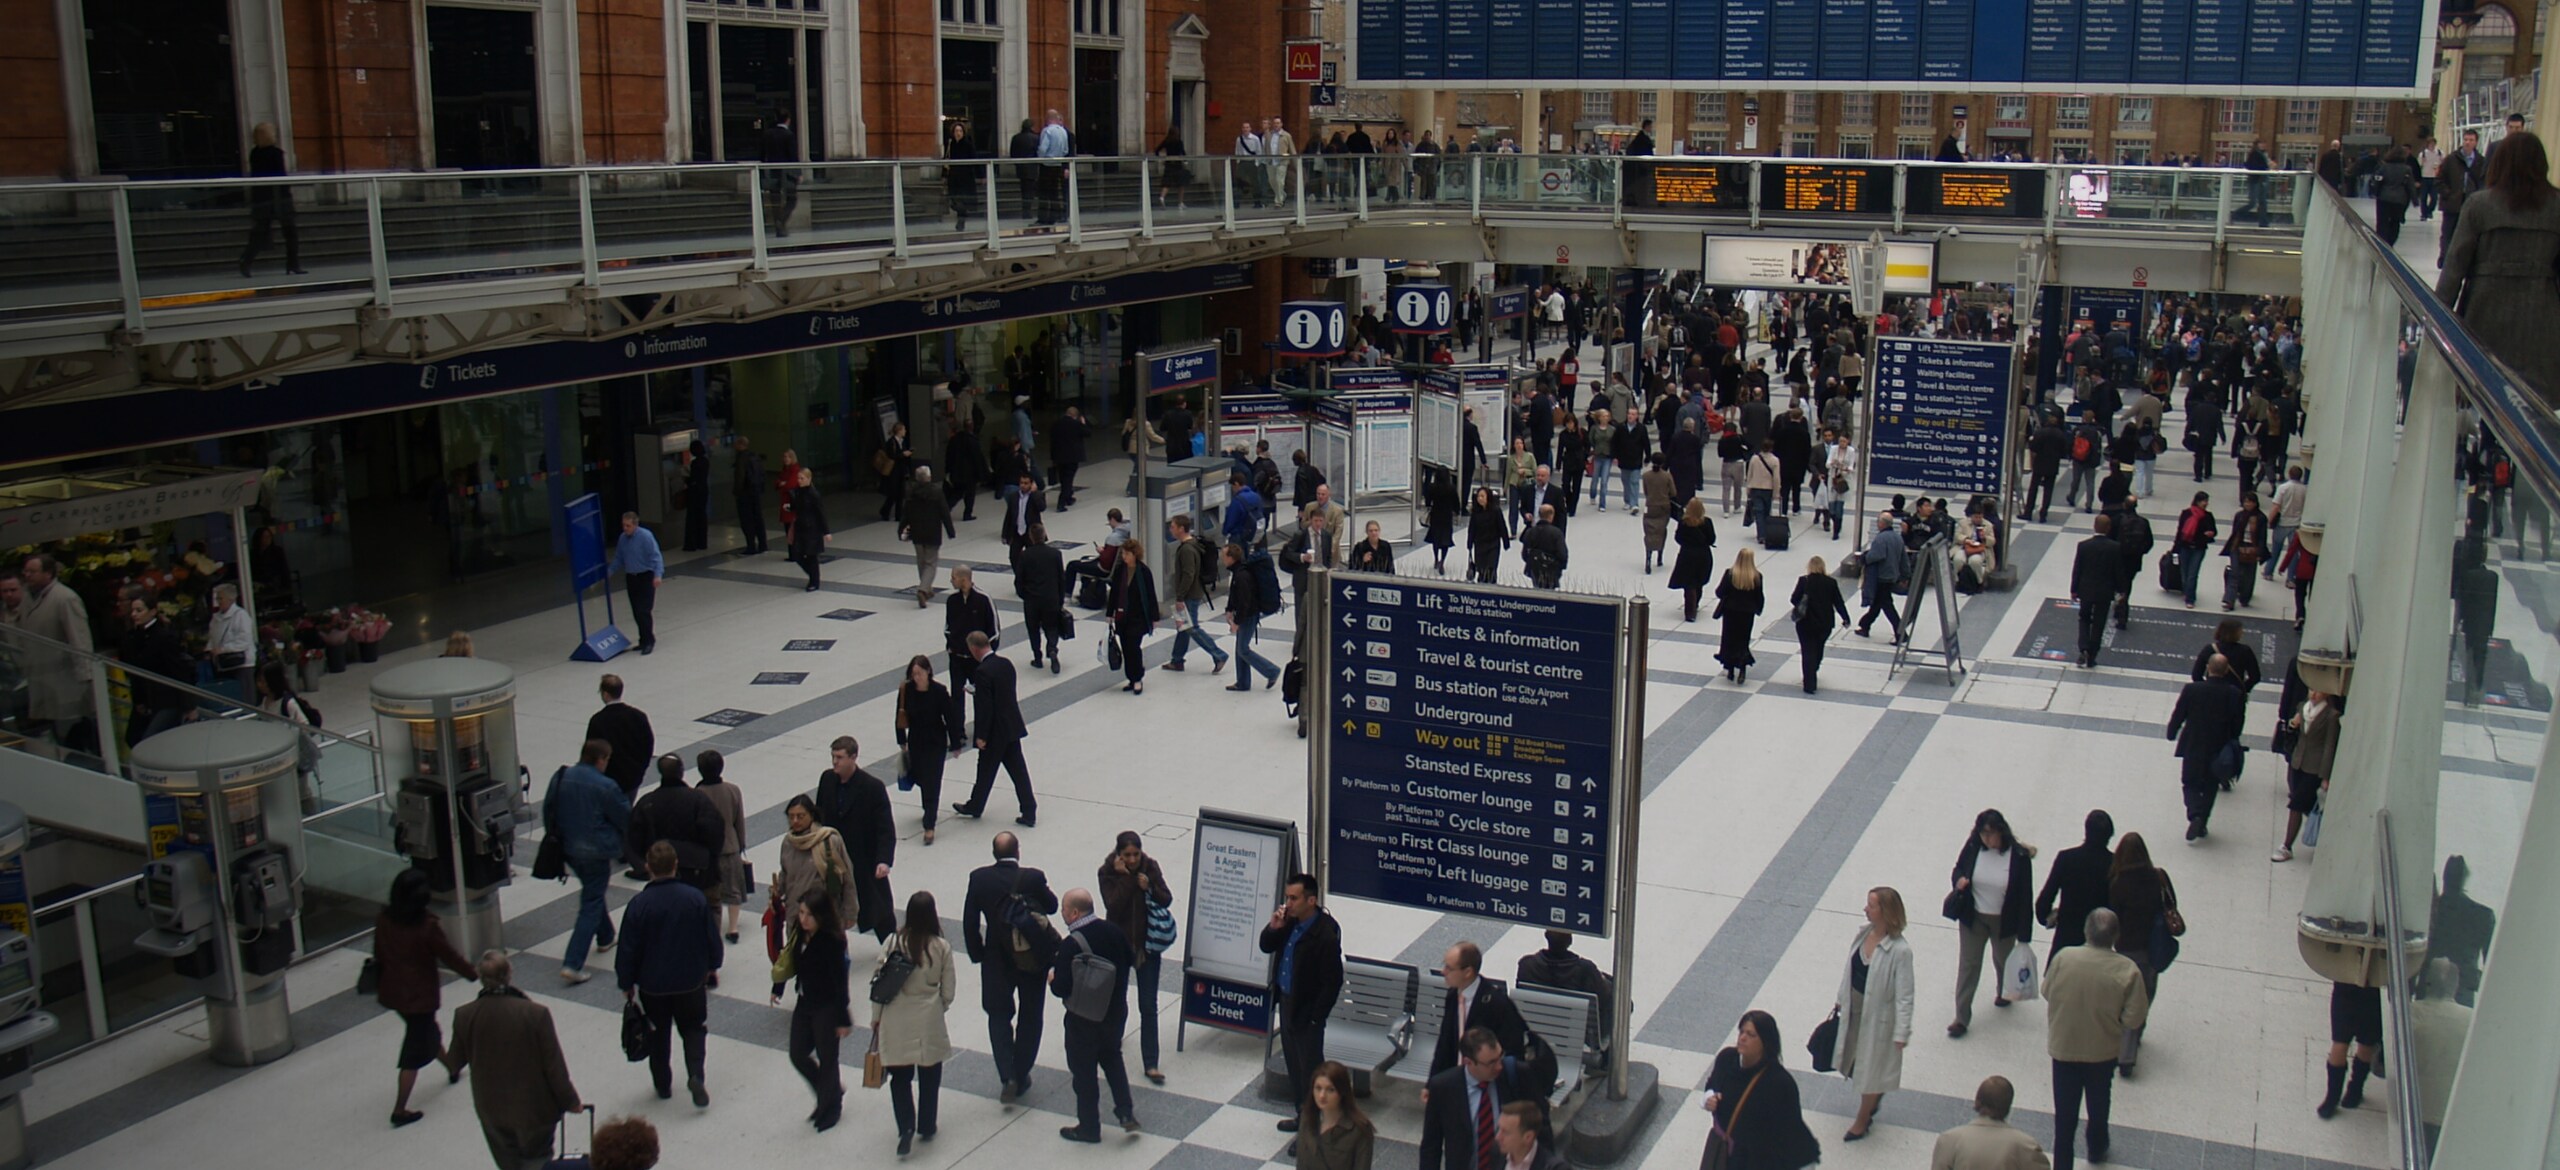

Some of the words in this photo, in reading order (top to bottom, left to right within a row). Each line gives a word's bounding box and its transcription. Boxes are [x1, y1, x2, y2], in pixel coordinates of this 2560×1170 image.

[1084, 285, 1106, 298] Tickets
[828, 316, 860, 331] Tickets
[644, 335, 708, 356] Information
[1174, 356, 1204, 370] Self-service
[1918, 356, 1944, 365] Tickets
[1952, 359, 1994, 368] information
[448, 361, 497, 382] Tickets
[1174, 370, 1192, 380] tickets
[1917, 369, 1944, 378] Waiting
[1945, 370, 1976, 380] facilities
[1372, 376, 1402, 384] departures
[1916, 381, 1938, 390] Travel
[1946, 384, 1970, 392] tourist
[1241, 404, 1253, 412] Bus
[1914, 405, 1961, 416] Underground
[1914, 418, 1930, 427] Way
[1936, 432, 1956, 440] Cycle
[1906, 442, 1922, 450] First
[1943, 444, 1968, 454] lounge
[1929, 456, 1944, 464] Left
[1945, 457, 1974, 466] luggage
[1954, 470, 1972, 478] Taxis
[1886, 476, 1918, 486] Stansted
[1919, 479, 1946, 488] Express
[1948, 481, 1972, 490] tickets
[81, 506, 162, 526] FLOWERS
[1416, 592, 1443, 610] Lift
[1448, 594, 1459, 604] To
[1460, 595, 1479, 608] Way
[1480, 598, 1498, 608] out,
[1499, 600, 1556, 614] Underground
[1448, 605, 1464, 614] and
[1466, 606, 1482, 616] Bus
[1482, 608, 1512, 619] station
[1417, 620, 1470, 641] Tickets
[1474, 626, 1486, 642] &
[1490, 629, 1580, 652] information
[1416, 648, 1460, 666] Travel
[1464, 652, 1476, 668] &
[1480, 656, 1530, 674] tourist
[1534, 664, 1584, 681] centre
[1415, 674, 1442, 692] Bus
[1446, 680, 1498, 698] station
[1502, 683, 1517, 692] For
[1518, 684, 1536, 696] City
[1538, 687, 1569, 700] Airport
[1502, 694, 1518, 703] use
[1519, 695, 1540, 706] door
[1540, 698, 1548, 706] A
[1415, 702, 1513, 728] Underground
[1416, 729, 1448, 750] Way
[1452, 737, 1480, 750] out
[1405, 754, 1470, 776] Stansted
[1474, 763, 1532, 784] Express
[1342, 777, 1352, 788] By
[1354, 778, 1389, 791] Platform
[1390, 784, 1400, 792] 10
[1406, 780, 1478, 804] Customer
[1482, 791, 1532, 813] lounge
[1386, 802, 1396, 812] By
[1398, 804, 1433, 817] Platform
[1434, 809, 1444, 818] 10
[1386, 812, 1402, 822] past
[1404, 814, 1421, 824] Taxi
[1422, 817, 1440, 827] rank
[1449, 813, 1490, 832] Cycle
[1492, 822, 1531, 838] store
[1340, 829, 1351, 840] By
[1352, 830, 1387, 844] Platform
[1388, 835, 1398, 846] 10
[1206, 842, 1226, 853] Great
[1228, 846, 1256, 858] Eastern
[1401, 832, 1434, 852] First
[1437, 838, 1475, 858] Class
[1478, 844, 1530, 866] lounge
[1214, 856, 1220, 864] &
[1222, 858, 1246, 870] Anglia
[1378, 850, 1388, 860] By
[1390, 850, 1425, 864] Platform
[1427, 856, 1437, 866] 10
[1379, 860, 1396, 871] Lost
[1397, 864, 1434, 878] property
[1437, 864, 1468, 882] Left
[1470, 868, 1530, 892] luggage
[1426, 893, 1438, 904] By
[1439, 894, 1474, 909] Platform
[1476, 900, 1486, 910] 10
[1492, 898, 1528, 918] Taxis
[1211, 984, 1264, 1008] Liverpool
[1209, 1002, 1245, 1022] Street
